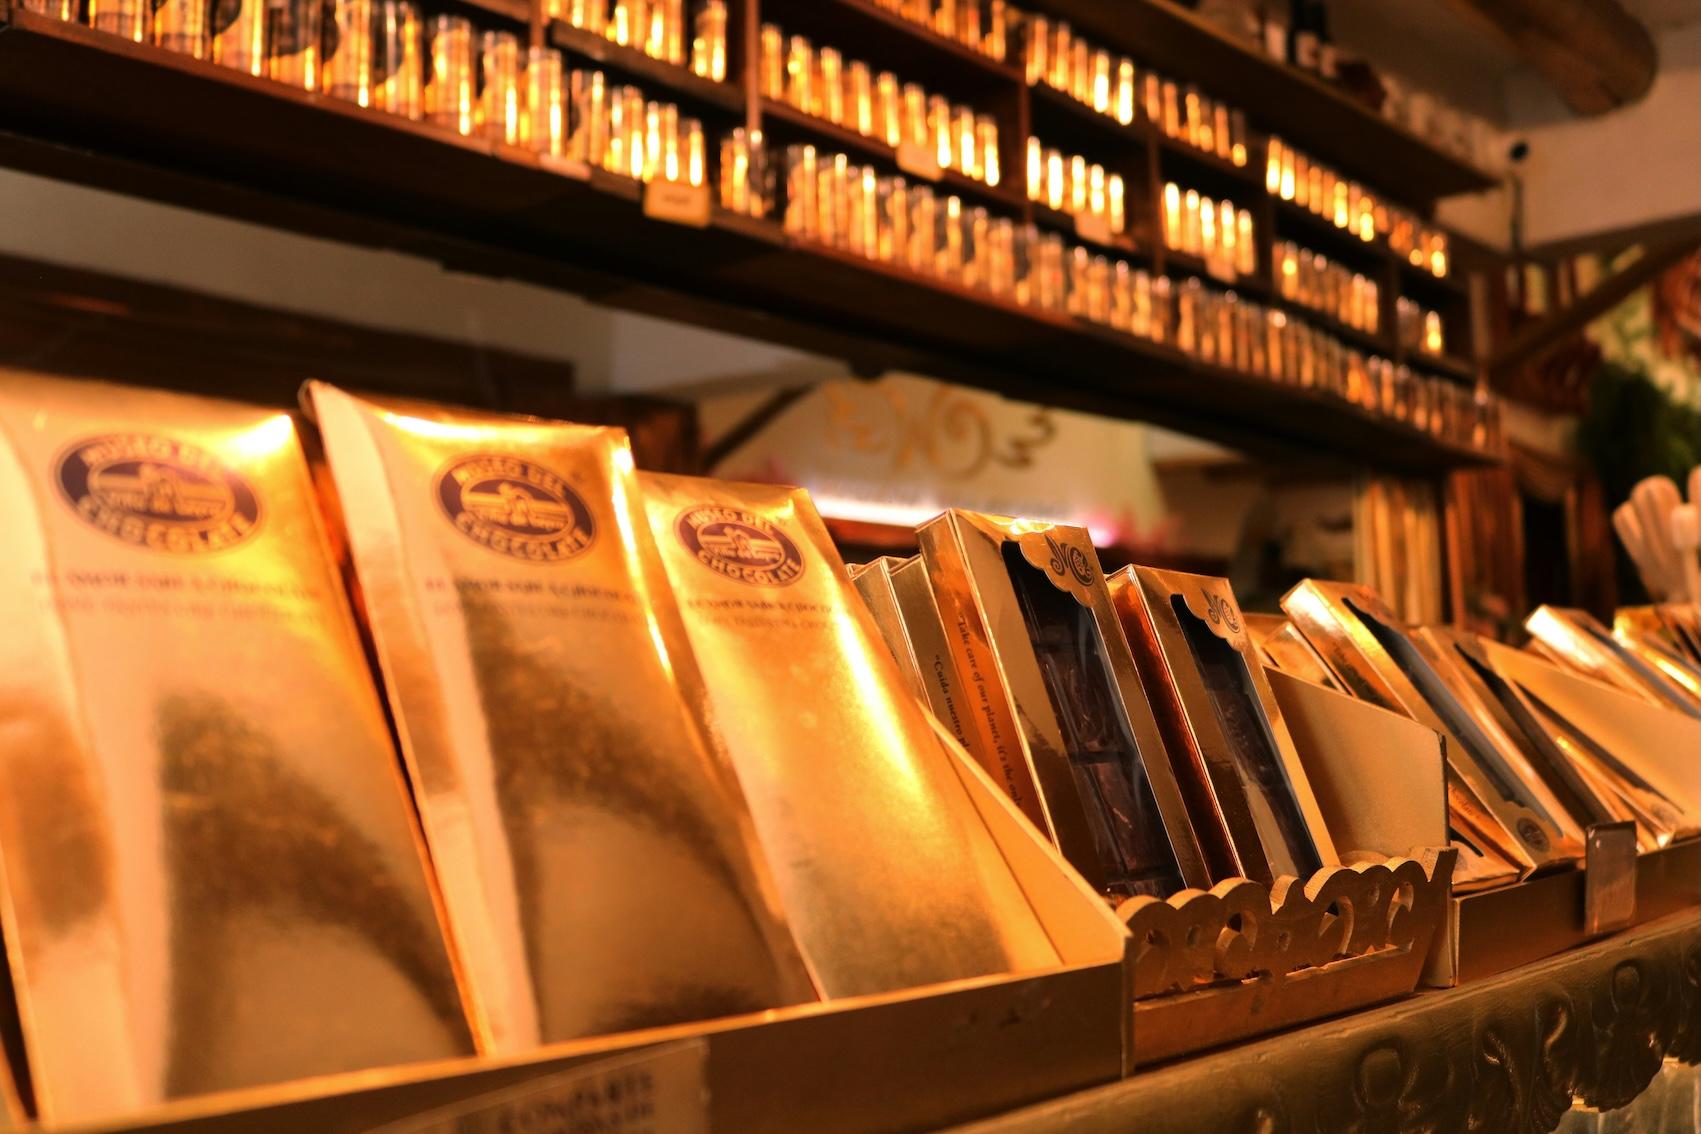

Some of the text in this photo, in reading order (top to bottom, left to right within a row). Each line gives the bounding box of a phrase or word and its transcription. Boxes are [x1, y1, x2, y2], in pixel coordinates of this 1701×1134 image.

[454, 511, 590, 562] CHOCOLATE
[698, 549, 801, 585] CHOCOLATE
[966, 648, 978, 668] care
[973, 671, 985, 682] of
[978, 684, 988, 702] our
[945, 697, 962, 735] nuestro
[1003, 763, 1014, 780] the
